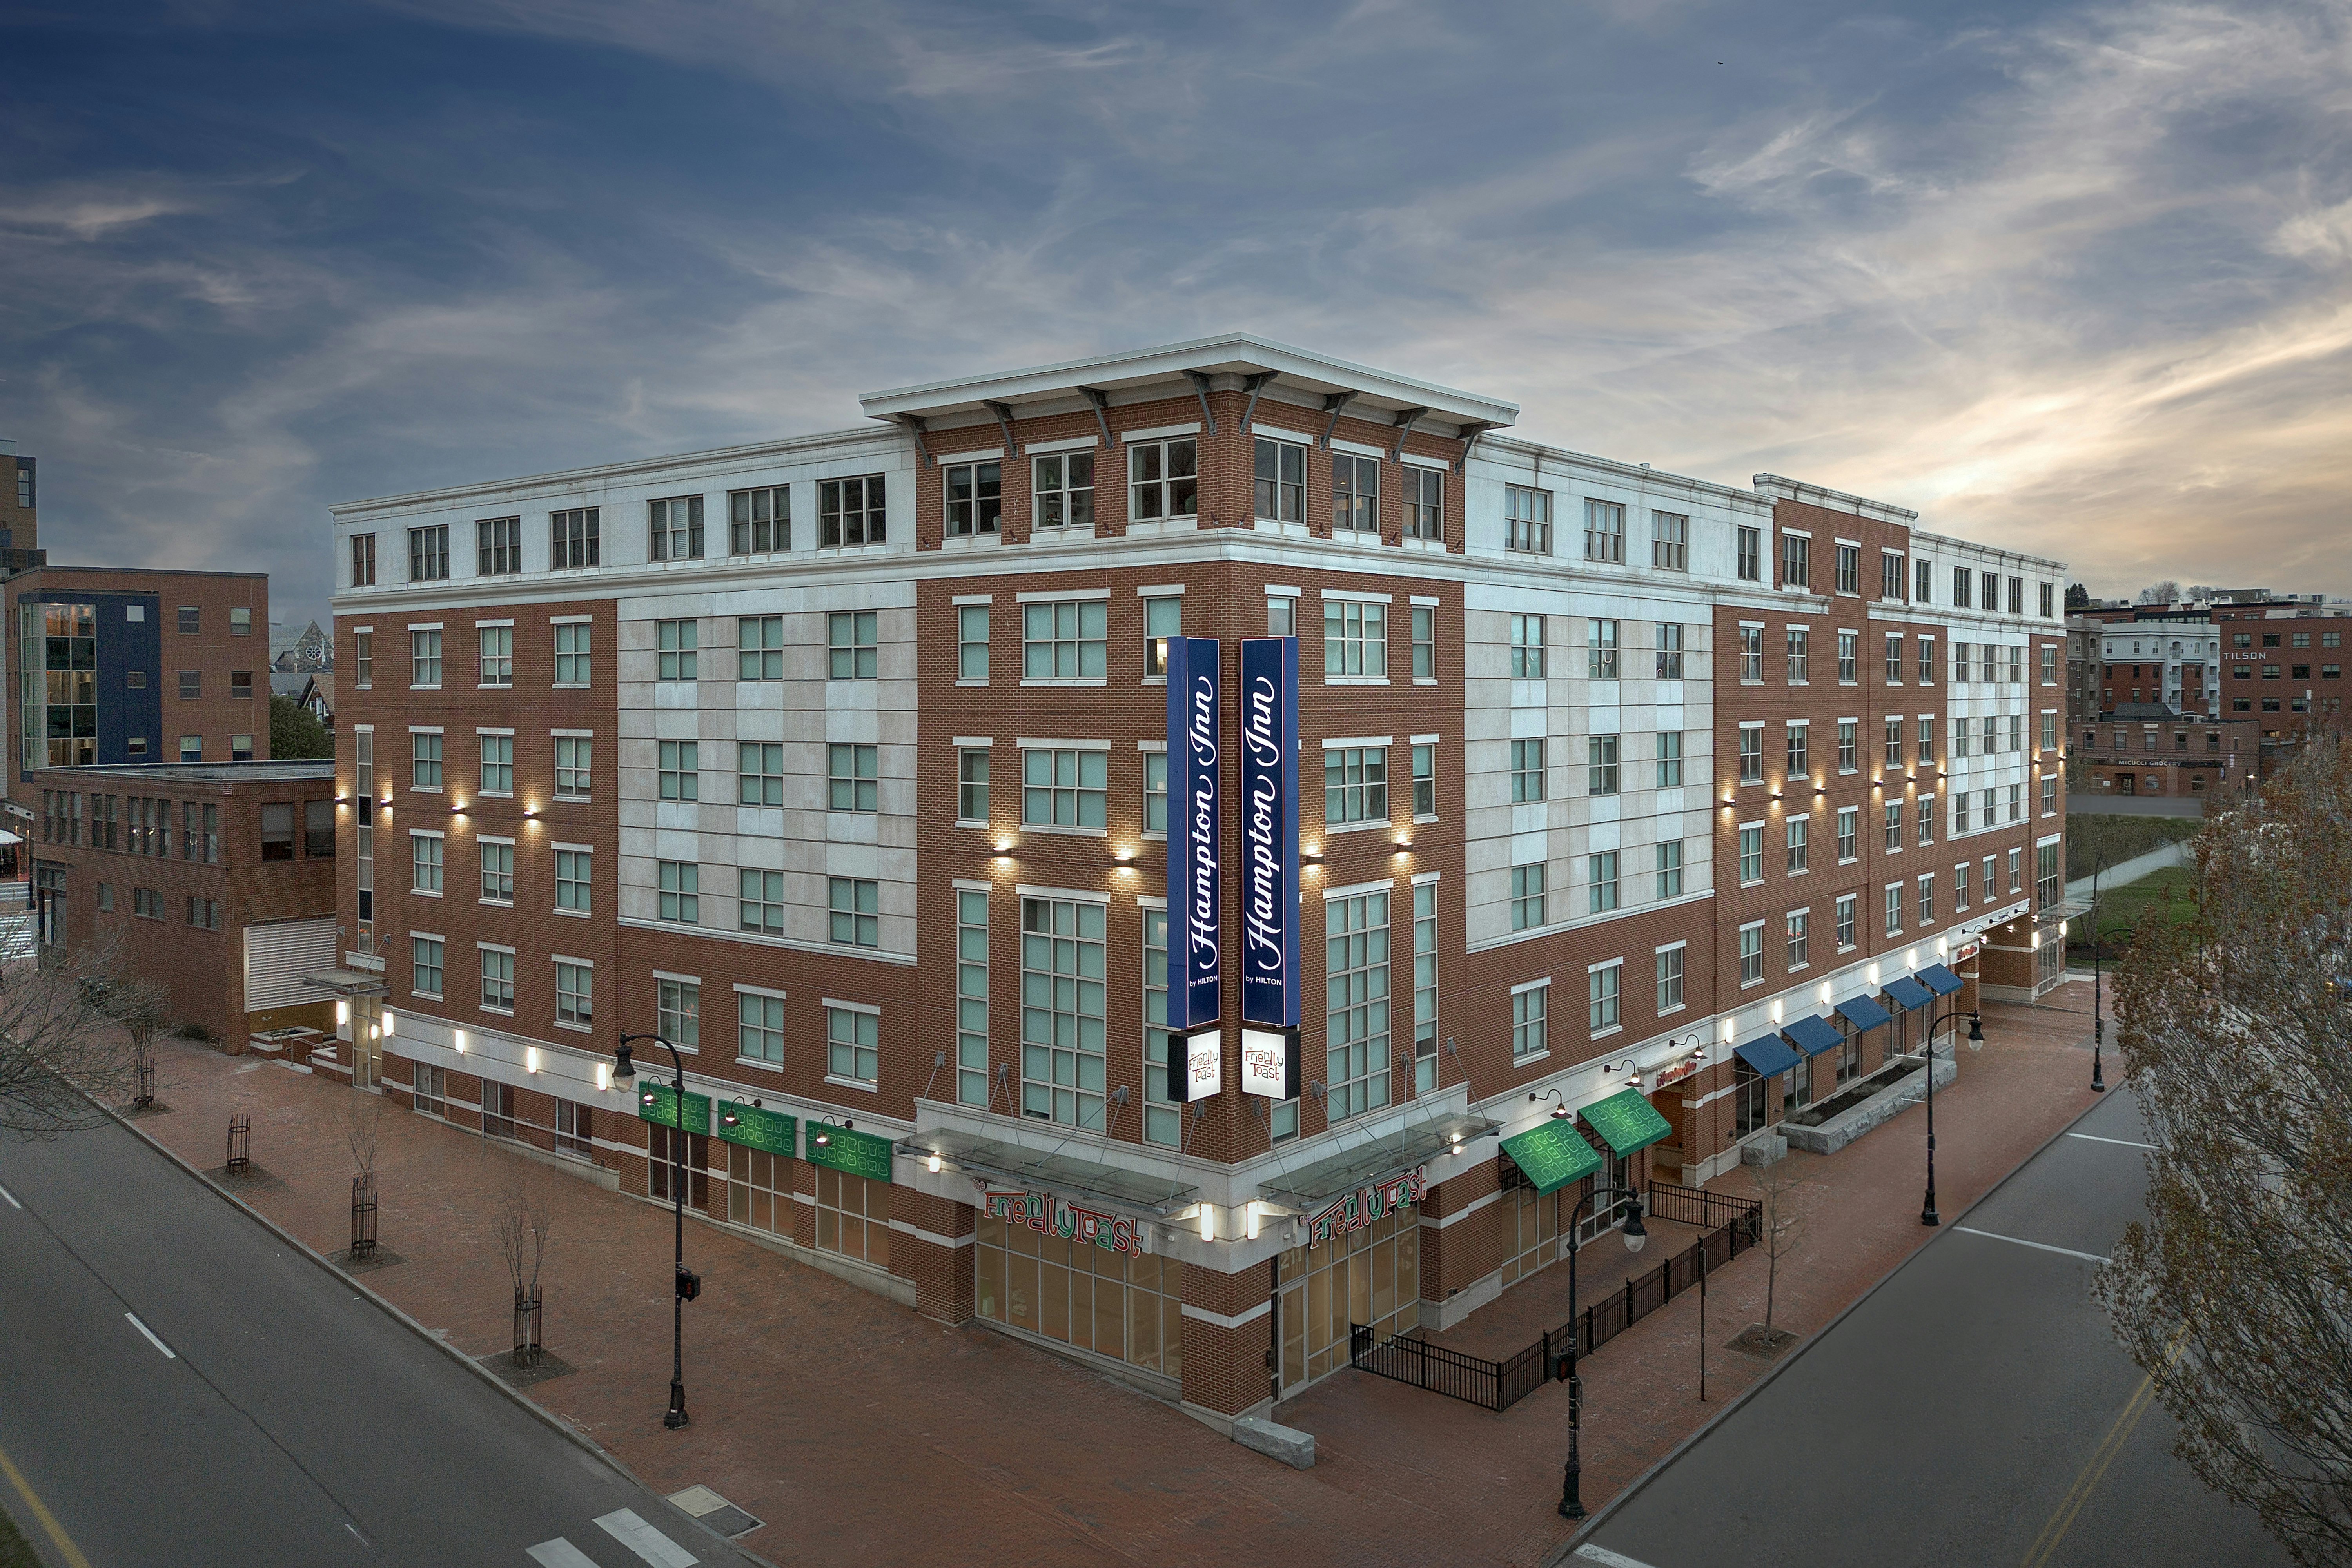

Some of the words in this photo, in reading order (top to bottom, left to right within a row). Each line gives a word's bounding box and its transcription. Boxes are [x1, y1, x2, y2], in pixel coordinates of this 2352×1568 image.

[1189, 676, 1216, 766] Inn
[1245, 677, 1279, 767] Inn
[1190, 775, 1217, 969] Hampton
[1246, 775, 1281, 970] Hampton
[1198, 975, 1218, 985] HILTON
[1246, 975, 1254, 984] by
[1256, 976, 1282, 986] HILTON
[1189, 1049, 1218, 1070] Friendly
[1245, 1050, 1283, 1067] Friendly
[1192, 1063, 1215, 1083] Toast
[1250, 1063, 1279, 1081] Toast
[972, 1179, 986, 1191] the
[1310, 1189, 1382, 1250] Friendly
[1376, 1165, 1427, 1218] Toast
[983, 1190, 1074, 1238] Friendly
[1066, 1201, 1142, 1258] Toast
